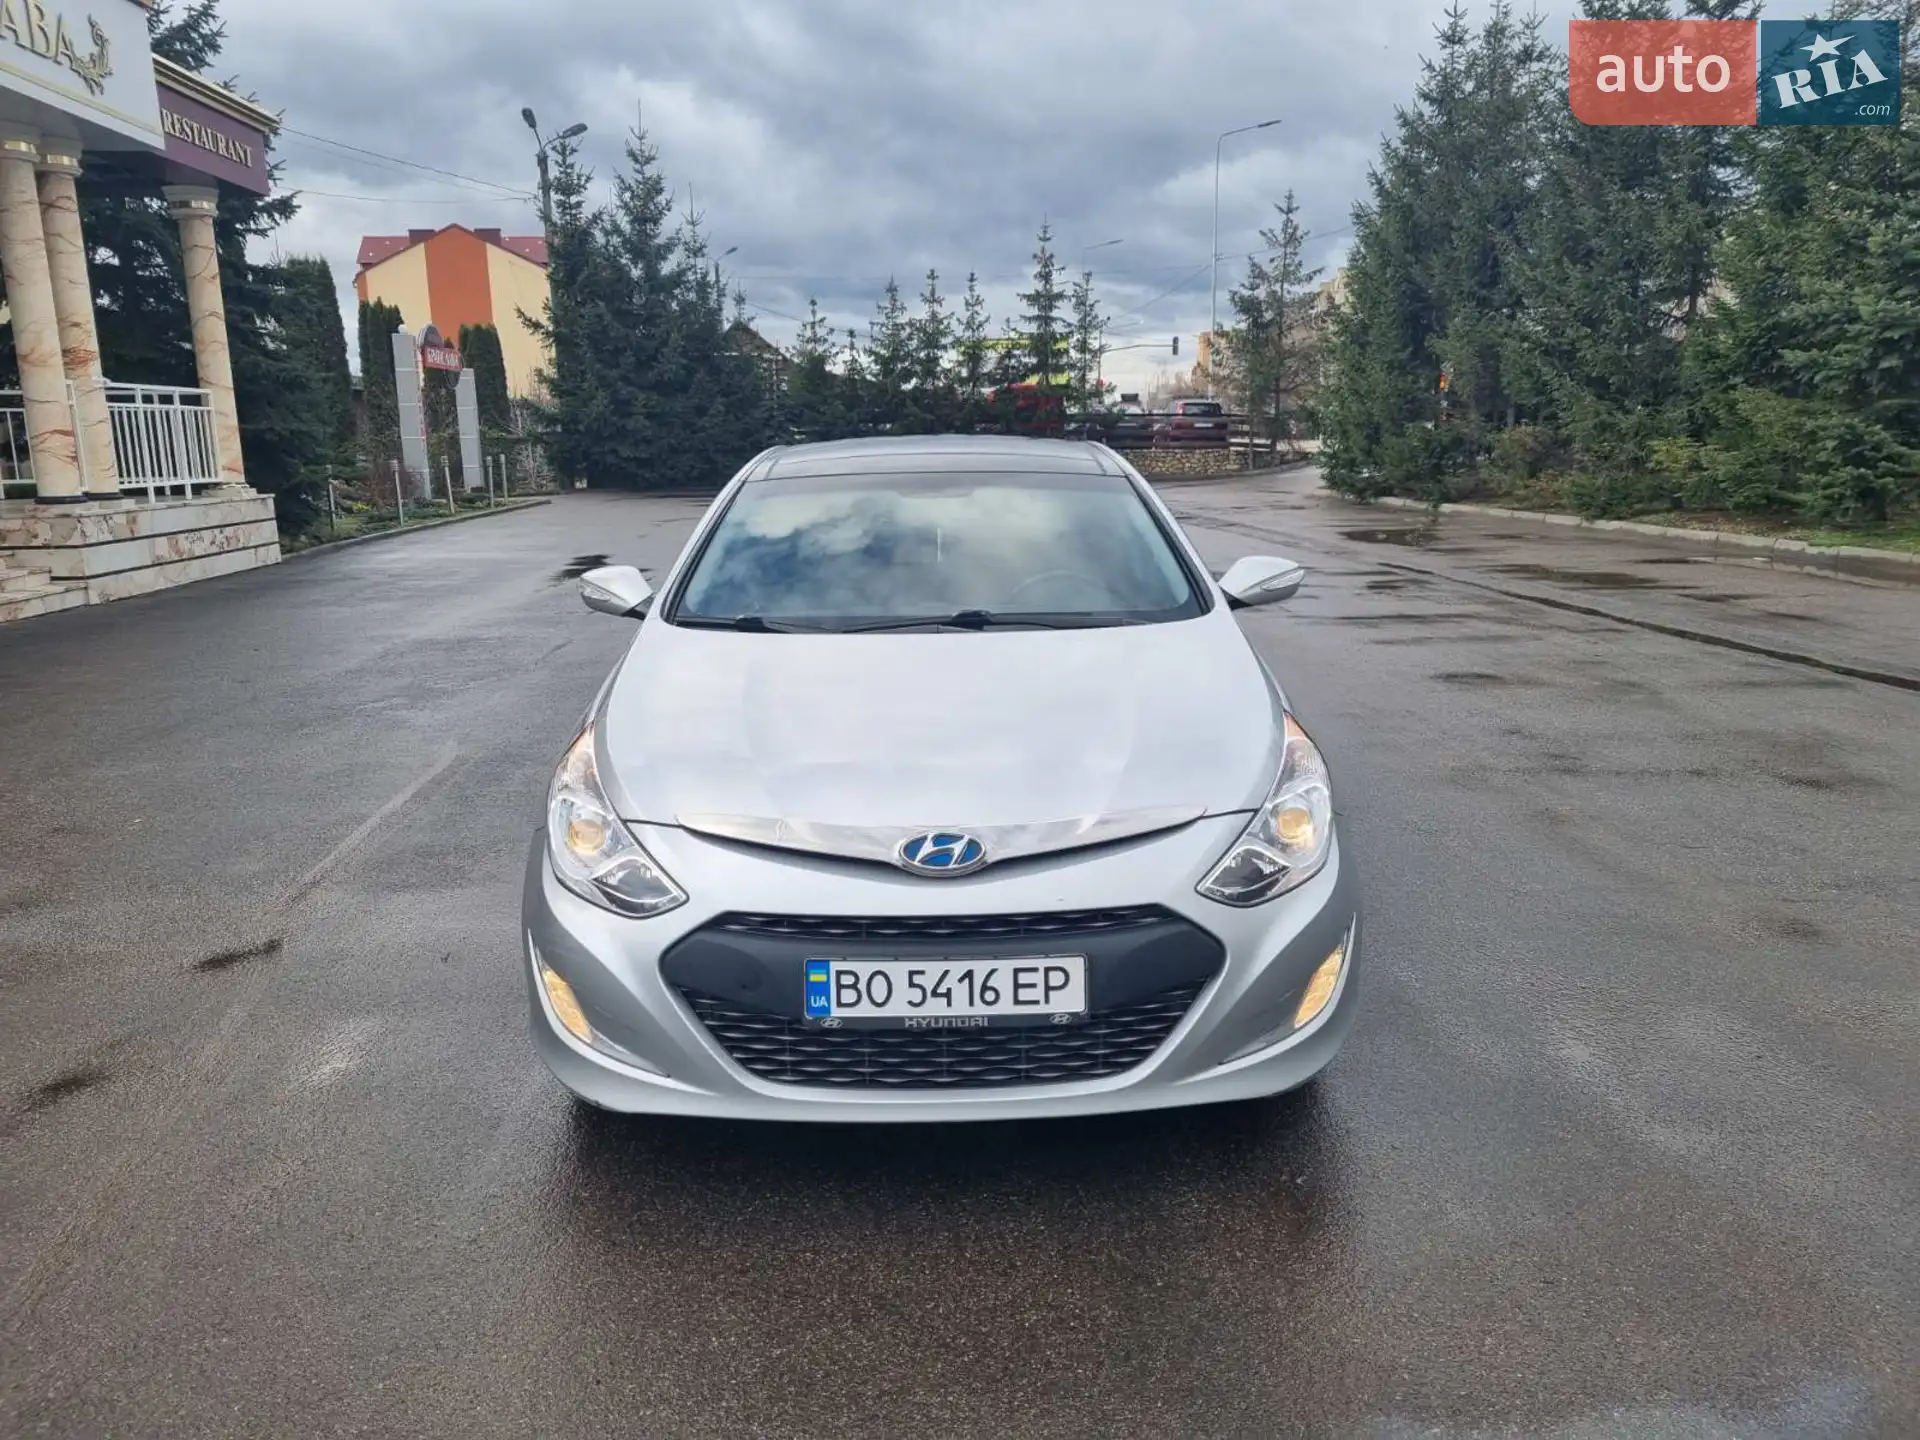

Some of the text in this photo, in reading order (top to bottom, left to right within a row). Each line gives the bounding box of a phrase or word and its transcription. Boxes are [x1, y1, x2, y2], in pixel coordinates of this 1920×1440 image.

[161, 108, 253, 168] RESTAURANT
[835, 965, 1071, 1009] BO 5416 EP
[810, 995, 829, 1009] UA
[904, 1016, 989, 1029] HYUNDAI
